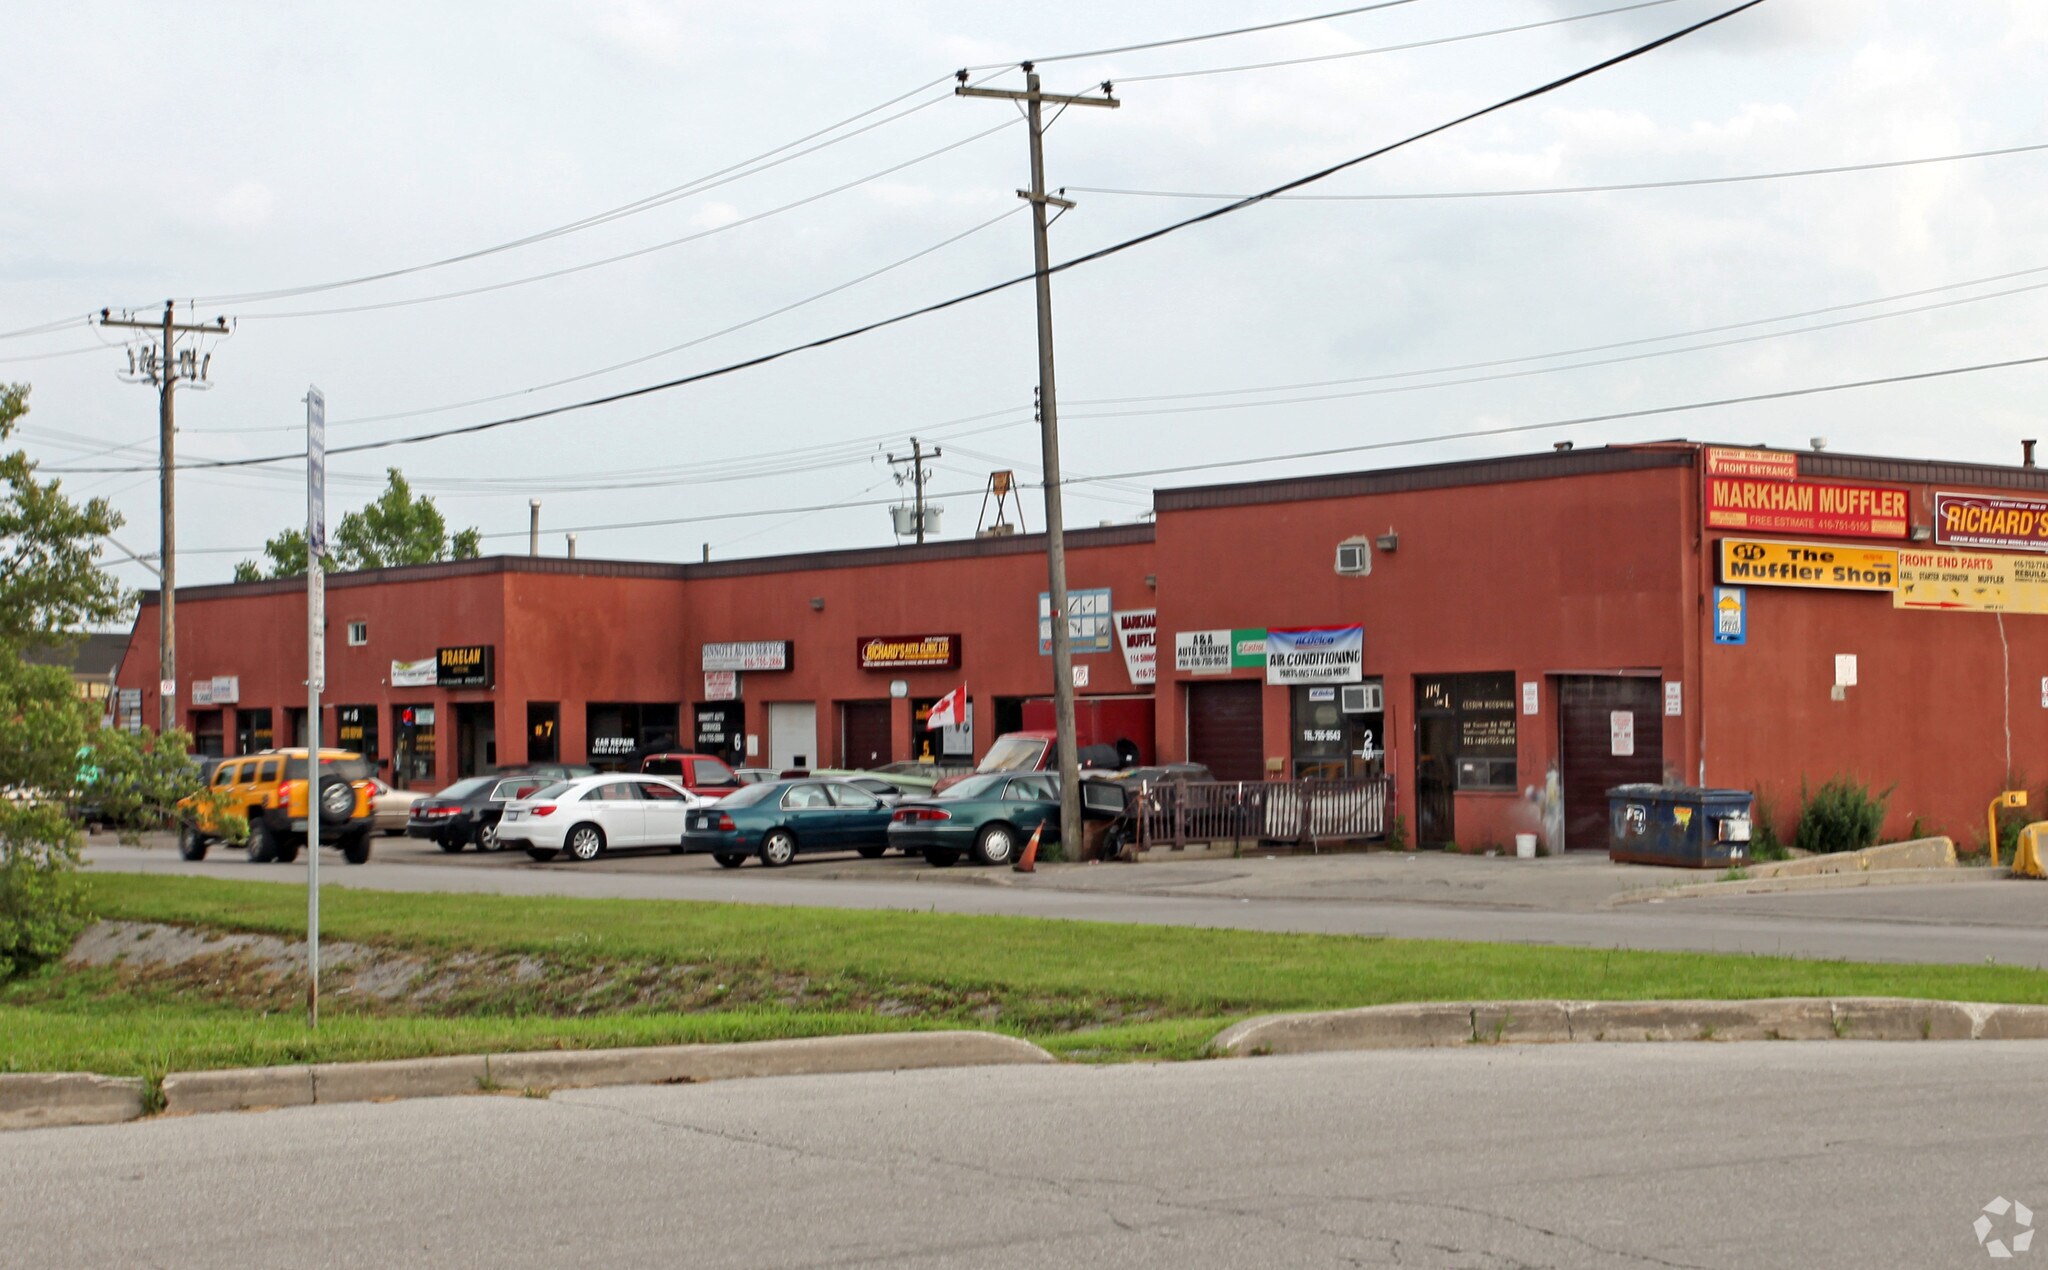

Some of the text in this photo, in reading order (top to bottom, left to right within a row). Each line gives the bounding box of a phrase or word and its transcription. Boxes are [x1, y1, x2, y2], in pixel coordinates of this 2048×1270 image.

[1718, 462, 1793, 477] FRONT ENTRANCE
[1713, 480, 1905, 518] MARKHAM MUFFLER
[1749, 515, 1772, 526] FREE
[1774, 516, 1814, 528] ESTIMATE
[1786, 548, 1834, 563] The
[1900, 553, 1993, 571] FRONT END PARTS
[1731, 561, 1891, 585] Muffler Shop
[1919, 571, 1939, 581] STARTER
[1941, 573, 1969, 583] ALTERNATOR
[1977, 575, 2004, 585] MUFFLER
[2014, 570, 2046, 578] REBUILD
[441, 648, 481, 667] BRAELAN
[866, 643, 905, 660] RICHARD'S
[905, 643, 919, 654] AUTO
[1178, 645, 1229, 657] AUTO SERVICE
[1287, 650, 1360, 666] CONDITIONING
[1280, 667, 1350, 678] PARTS INSTALLED HERE
[1425, 683, 1440, 699] 114
[545, 721, 553, 737] 7
[610, 738, 635, 747] REPAIR
[734, 733, 741, 751] 6
[1363, 729, 1373, 747] 2
